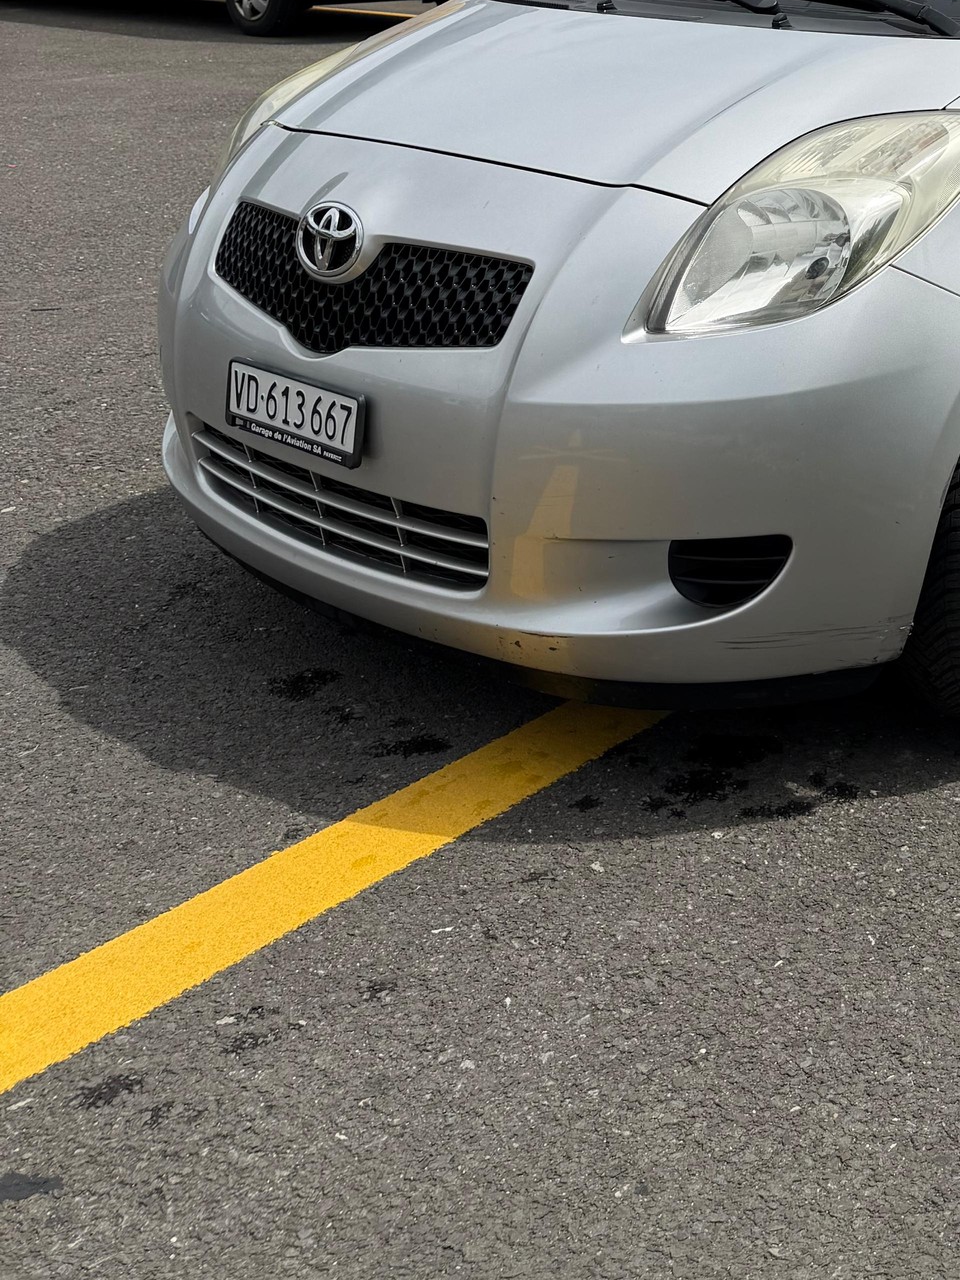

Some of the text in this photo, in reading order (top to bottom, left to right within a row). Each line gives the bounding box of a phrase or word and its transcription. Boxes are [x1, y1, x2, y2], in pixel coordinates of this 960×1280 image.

[251, 423, 273, 437] Garage
[273, 431, 282, 440] de
[282, 433, 312, 451] l'Aviation
[312, 444, 322, 455] SA
